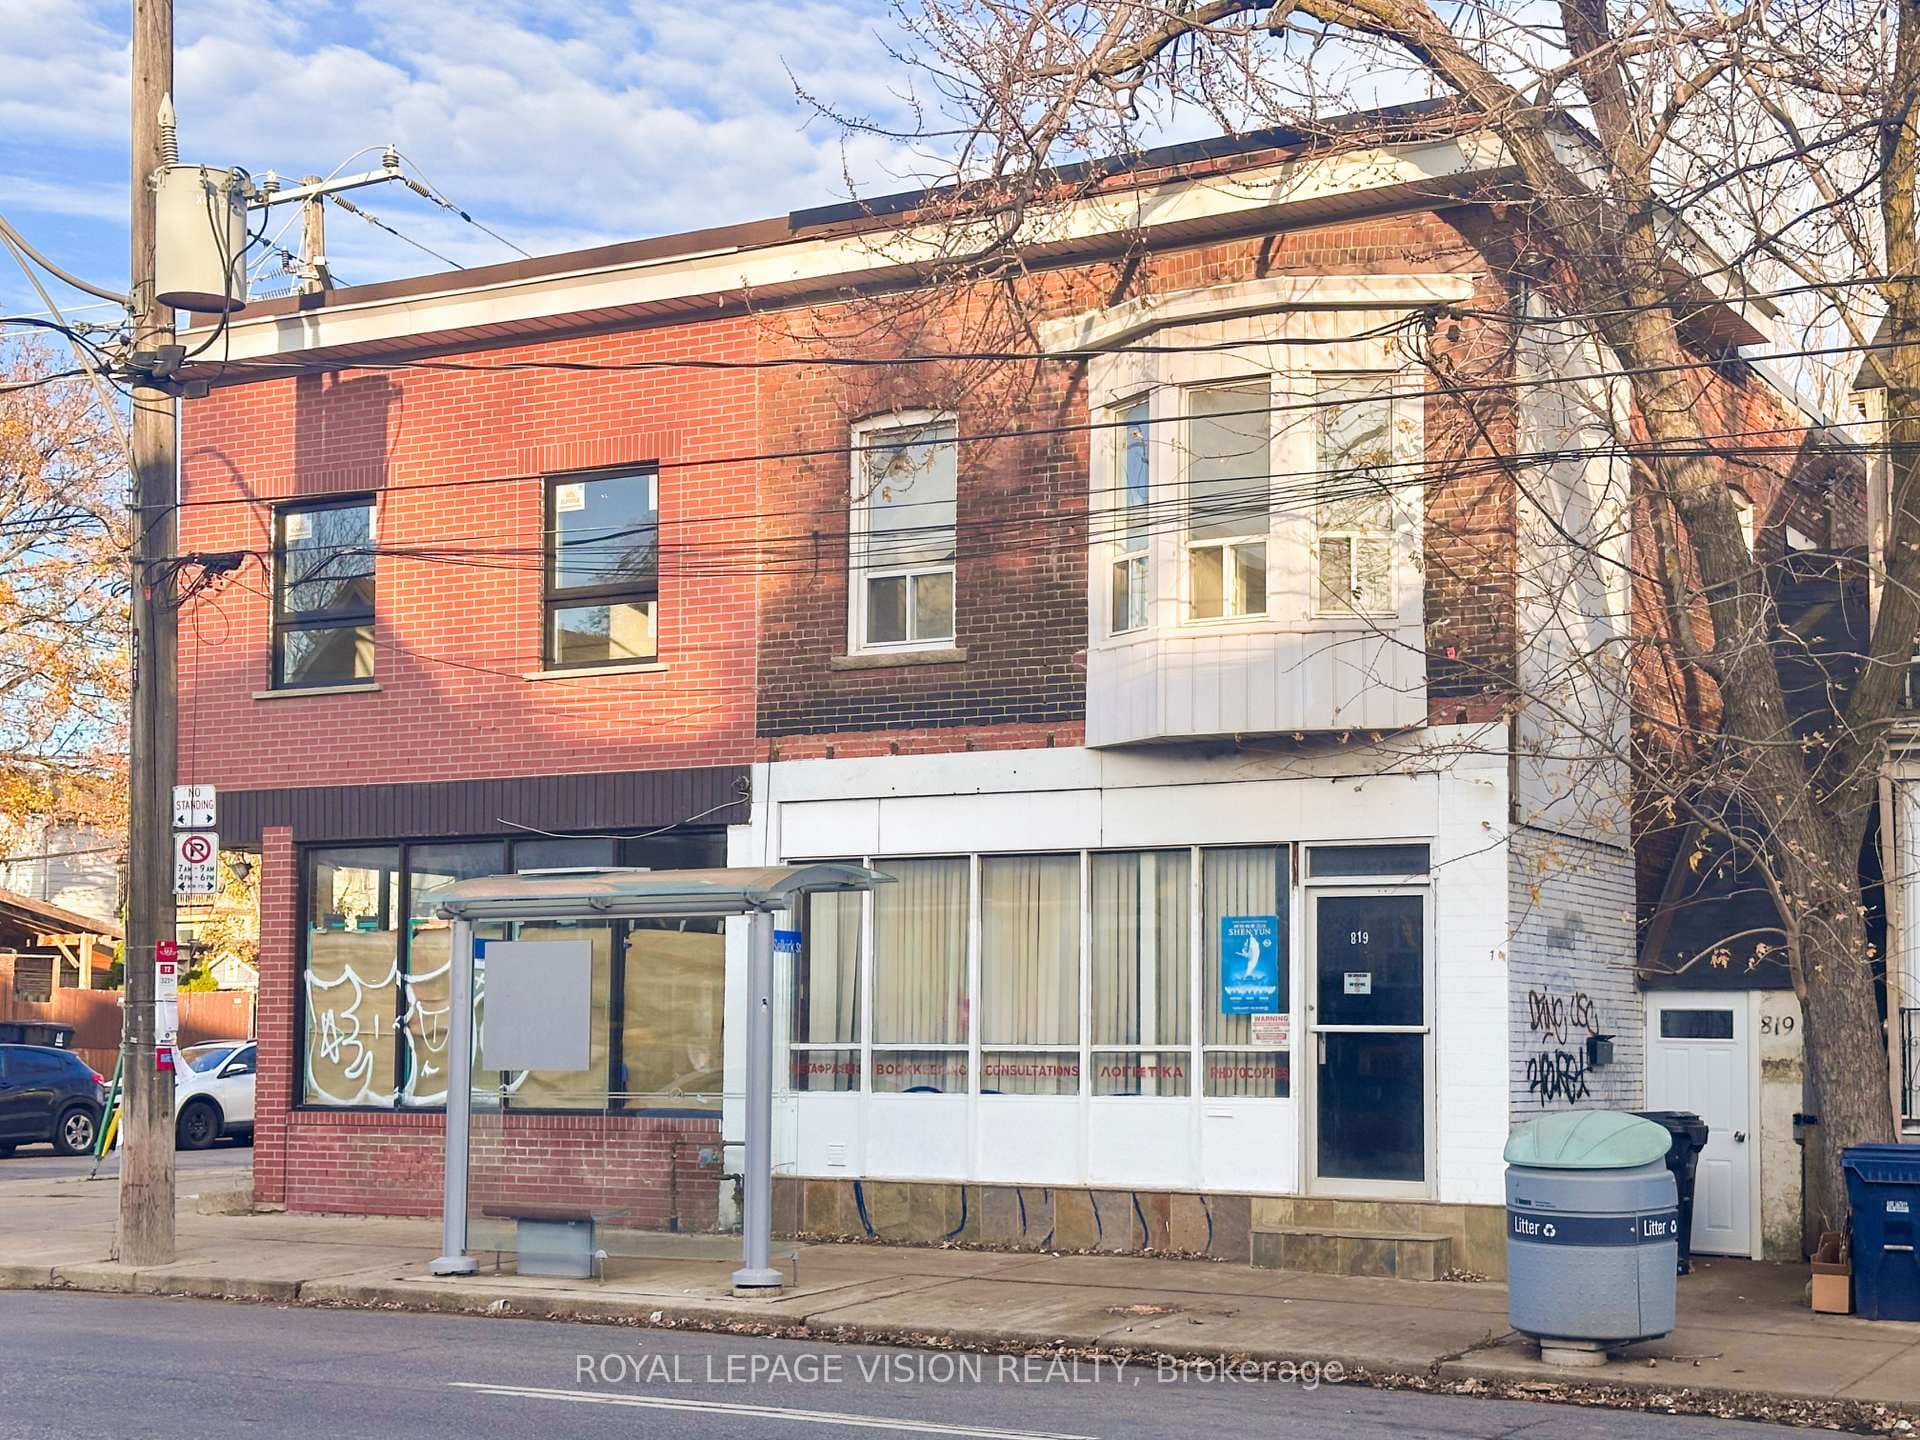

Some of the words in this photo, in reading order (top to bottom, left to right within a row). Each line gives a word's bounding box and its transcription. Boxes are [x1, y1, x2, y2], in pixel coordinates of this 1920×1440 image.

[188, 787, 201, 797] NO
[175, 799, 215, 811] STANDING
[1228, 928, 1251, 936] SHEN
[1253, 928, 1271, 936] YUN
[1350, 930, 1369, 945] 819
[1761, 1015, 1794, 1036] 819
[984, 1064, 1080, 1077] CONSULTATIONS
[1514, 1216, 1540, 1236] Litter
[1643, 1219, 1667, 1237] Litter
